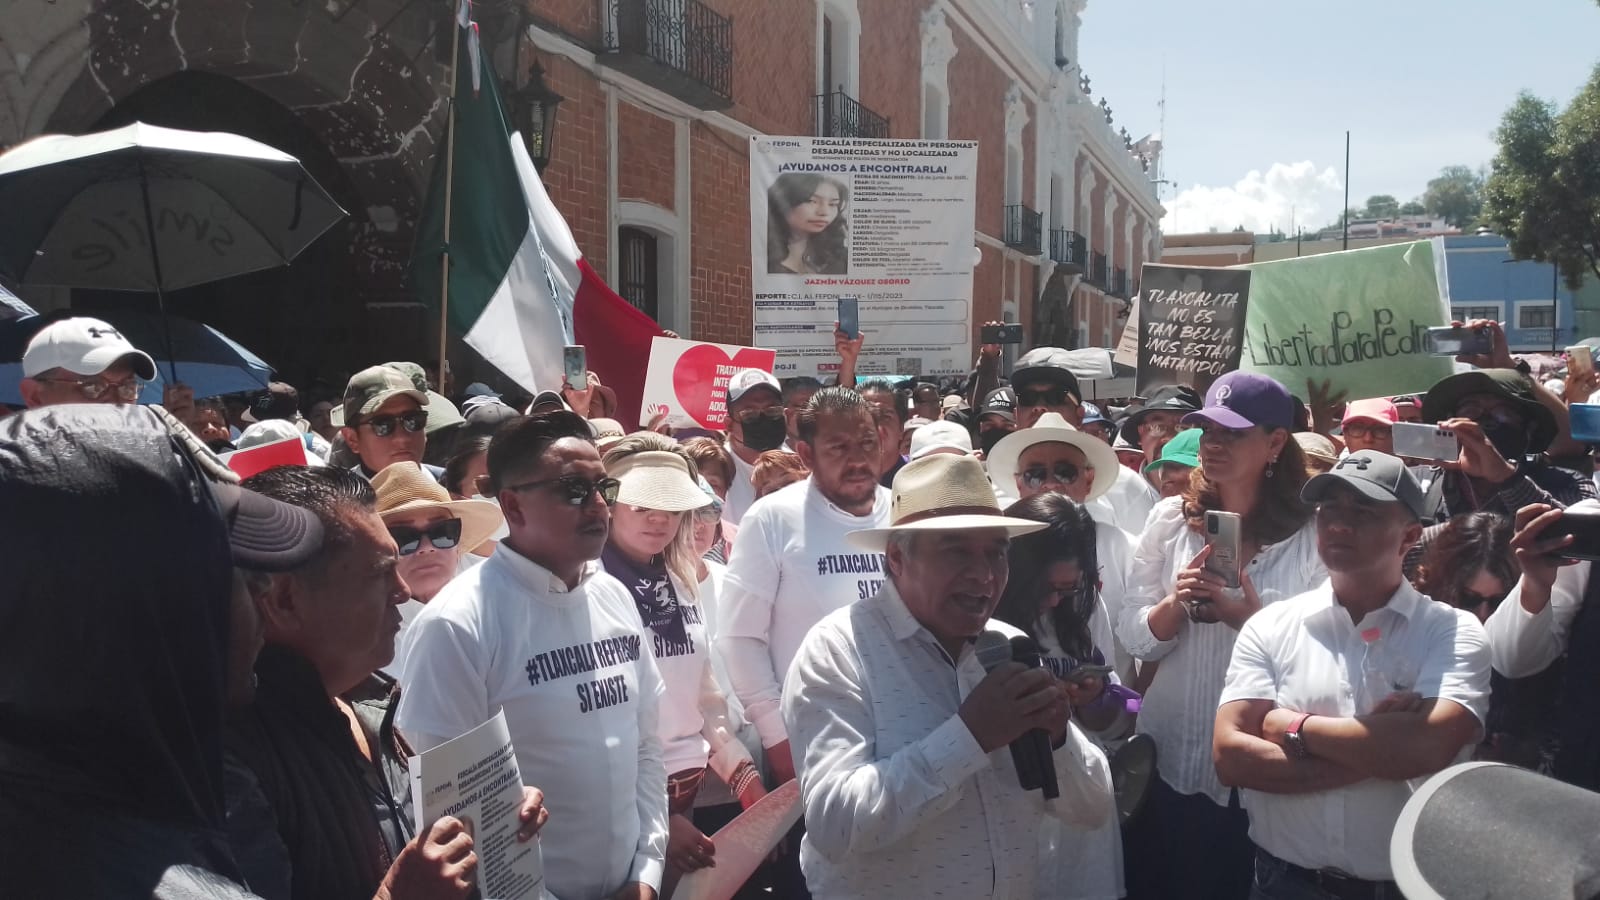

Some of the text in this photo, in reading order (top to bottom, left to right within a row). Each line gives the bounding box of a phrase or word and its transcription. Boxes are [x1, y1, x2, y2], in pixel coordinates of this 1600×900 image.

[812, 148, 880, 156] DESAPARECIDAS
[852, 140, 916, 148] ESPECIALIZADA
[778, 163, 947, 173] ¡AYUDANOS A ENCONTRARLA!
[804, 277, 837, 285] JAZMÍN
[838, 277, 875, 285] VÁZQUEZ
[1148, 288, 1239, 308] TLAXCALITA
[1166, 308, 1217, 324] NO ES
[1148, 322, 1234, 345] TAN BELLA
[1182, 342, 1236, 360] ESTAN
[1149, 354, 1226, 375] MATANDO!
[713, 377, 729, 388] INTE
[708, 401, 728, 412] ADOL
[818, 554, 880, 575] #TLAXCALA
[858, 580, 870, 599] SI
[654, 635, 664, 658] SI
[526, 642, 598, 686] #TLAXCALA
[576, 674, 629, 713] SI EXISTE
